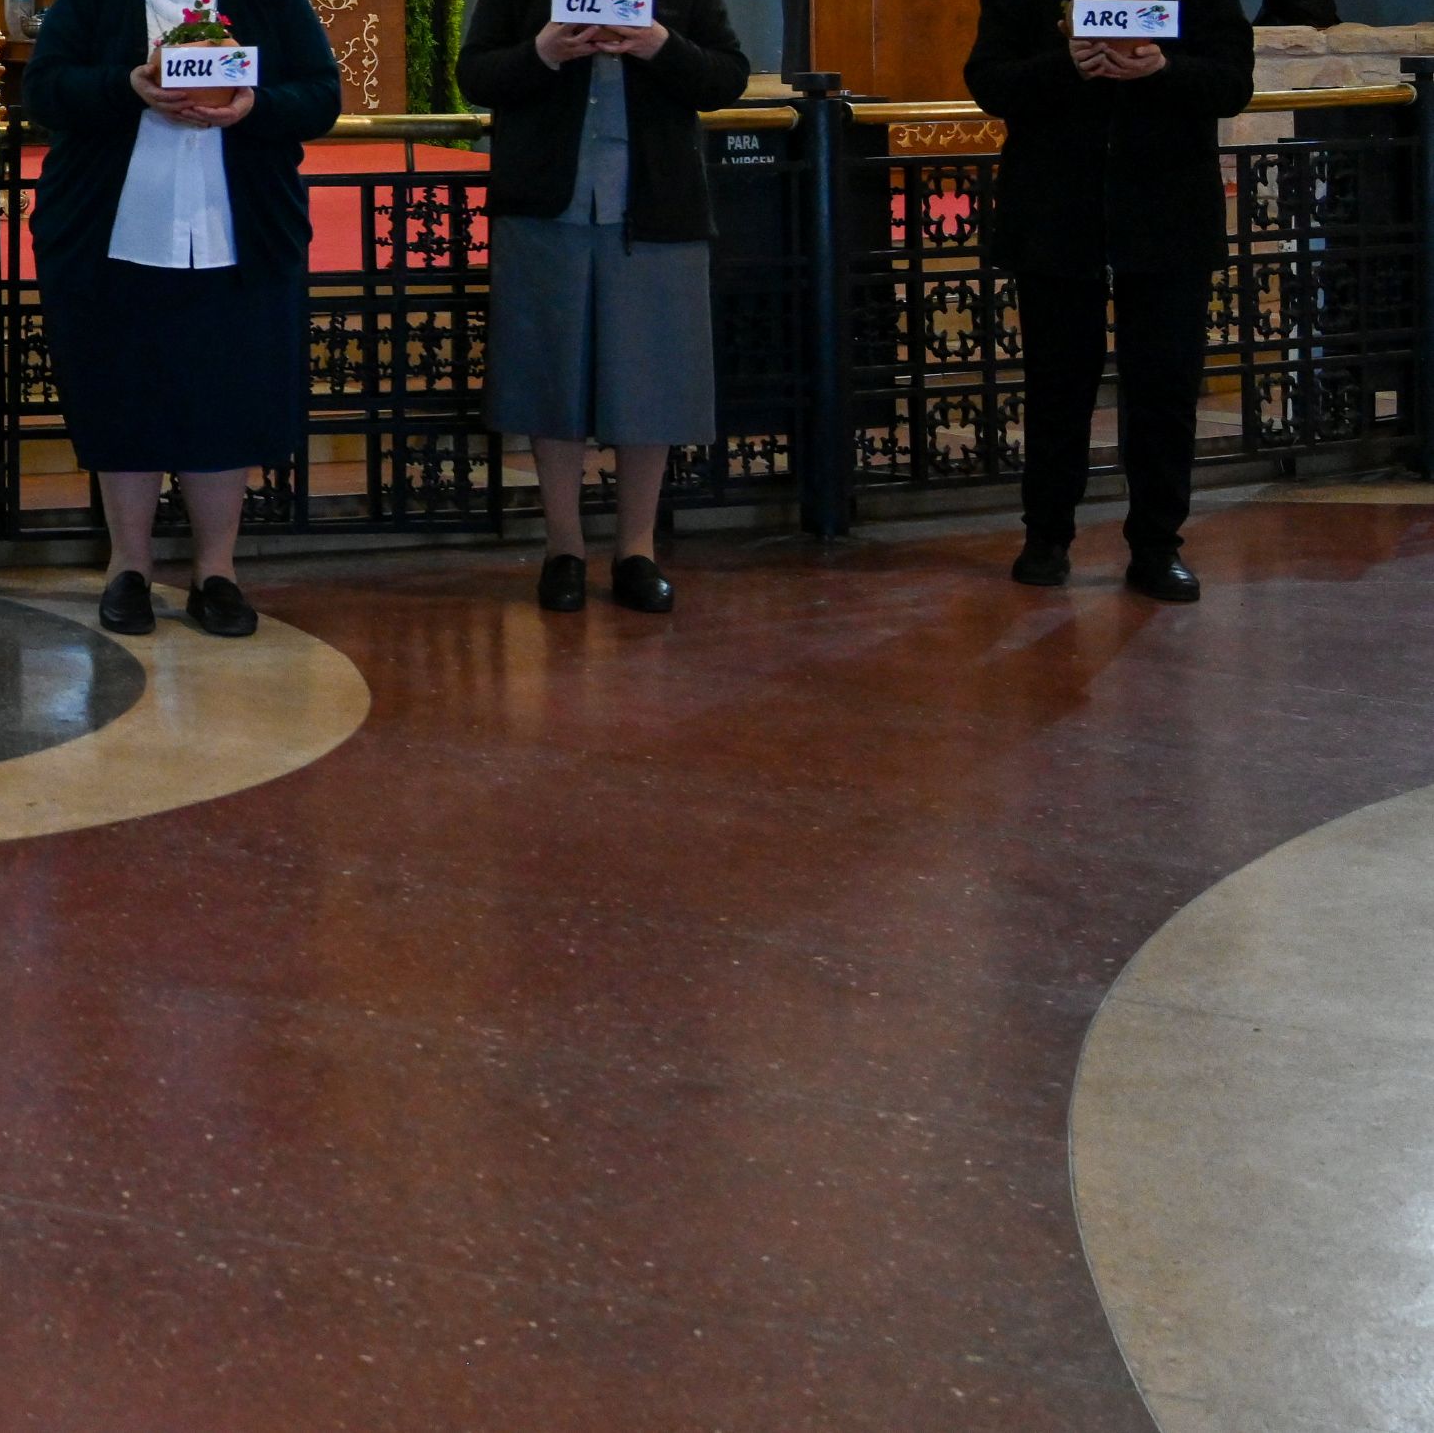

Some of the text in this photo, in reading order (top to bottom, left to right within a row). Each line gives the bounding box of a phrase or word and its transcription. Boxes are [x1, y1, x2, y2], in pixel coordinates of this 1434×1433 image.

[1082, 10, 1129, 30] ARG
[166, 58, 213, 78] URU
[727, 134, 760, 150] PARA
